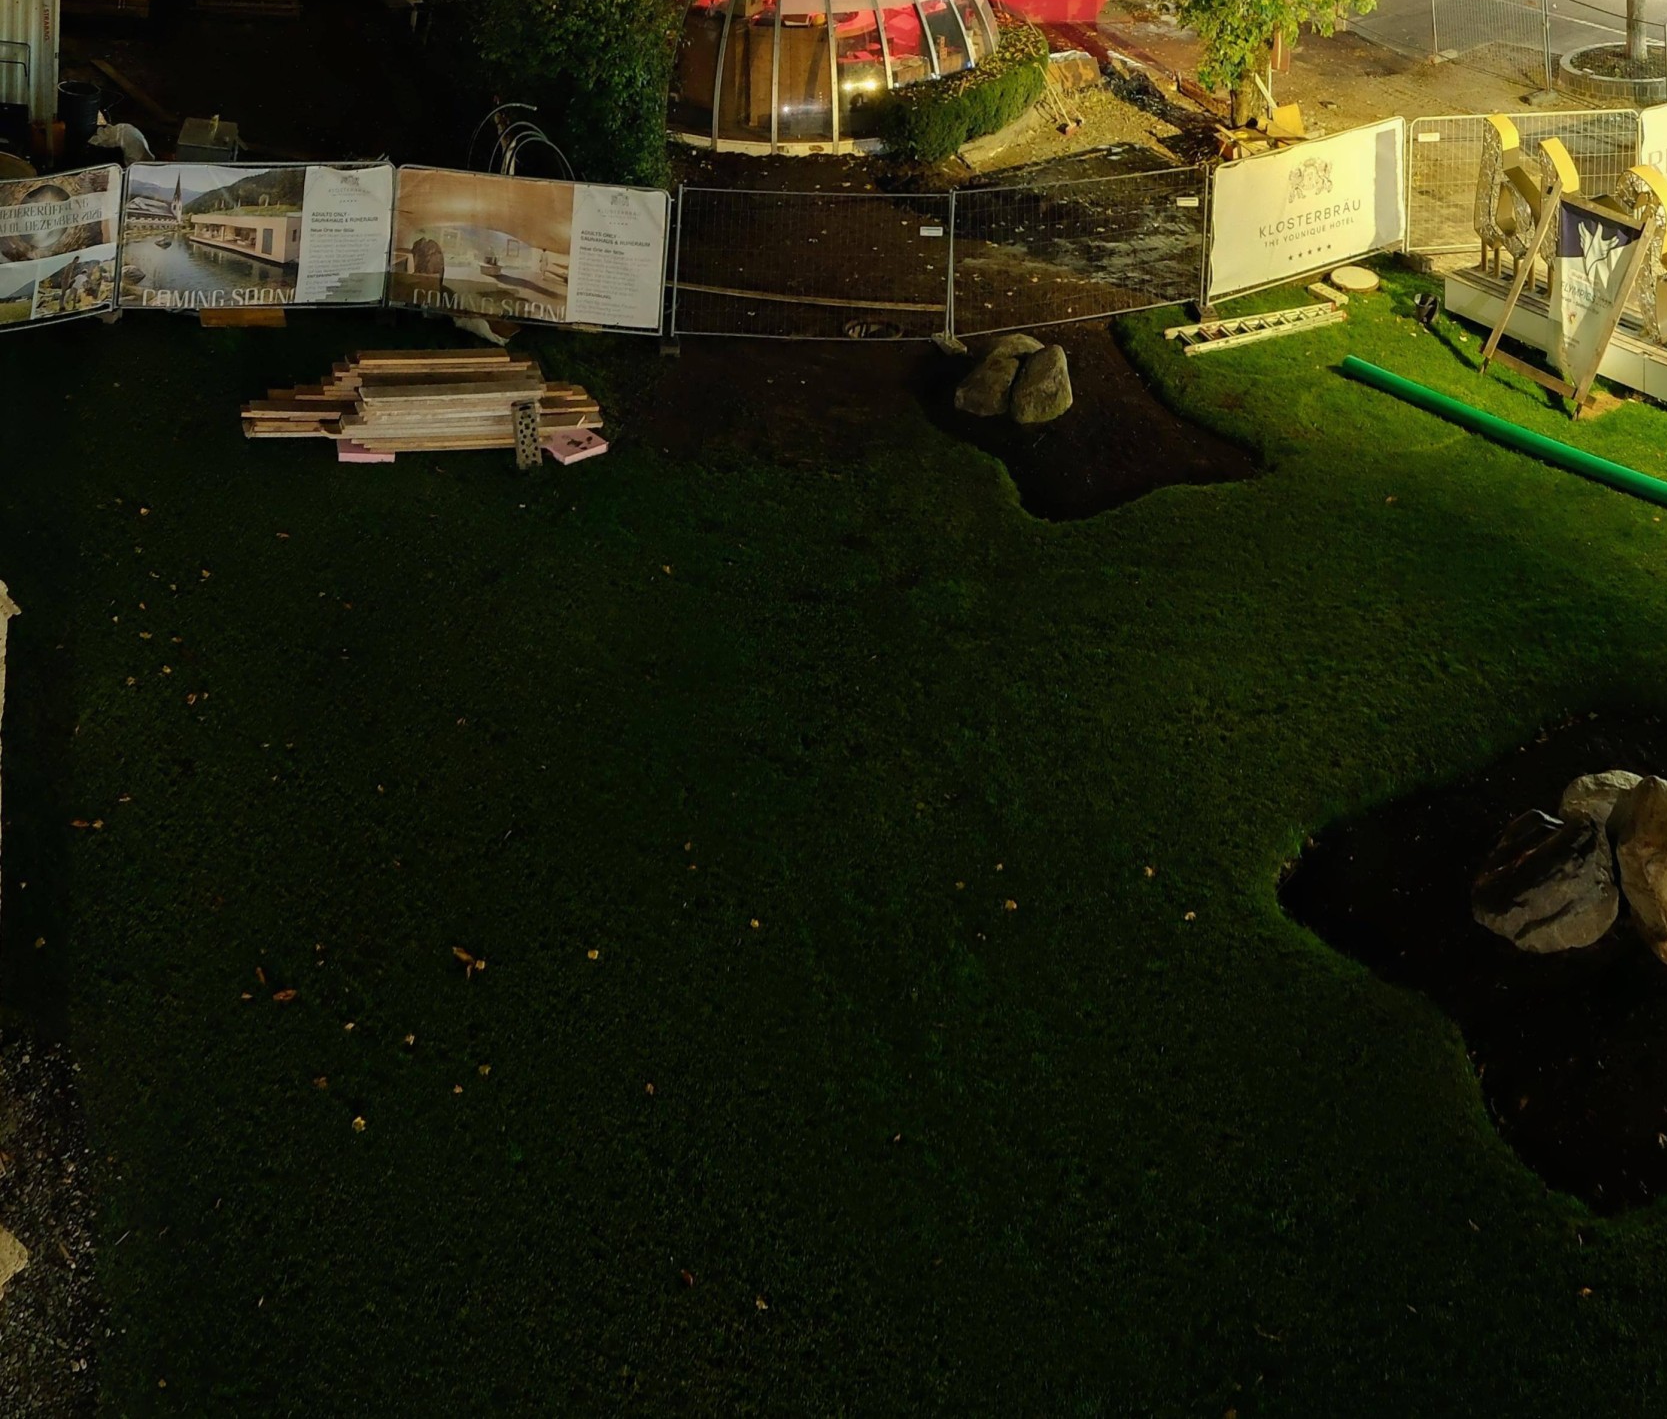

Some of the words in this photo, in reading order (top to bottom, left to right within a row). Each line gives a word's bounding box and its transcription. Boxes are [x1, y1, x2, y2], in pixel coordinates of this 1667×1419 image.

[25, 213, 80, 232] DEZEMBER
[1258, 199, 1362, 239] KLOSTERBRÄU
[1264, 239, 1279, 248] THE
[1283, 225, 1327, 243] YOUNIQUE
[1329, 217, 1355, 231] HOTEL
[142, 288, 225, 308] COMING
[231, 287, 296, 305] SOON!
[412, 287, 494, 317] COMING
[500, 298, 567, 324] SOON!
